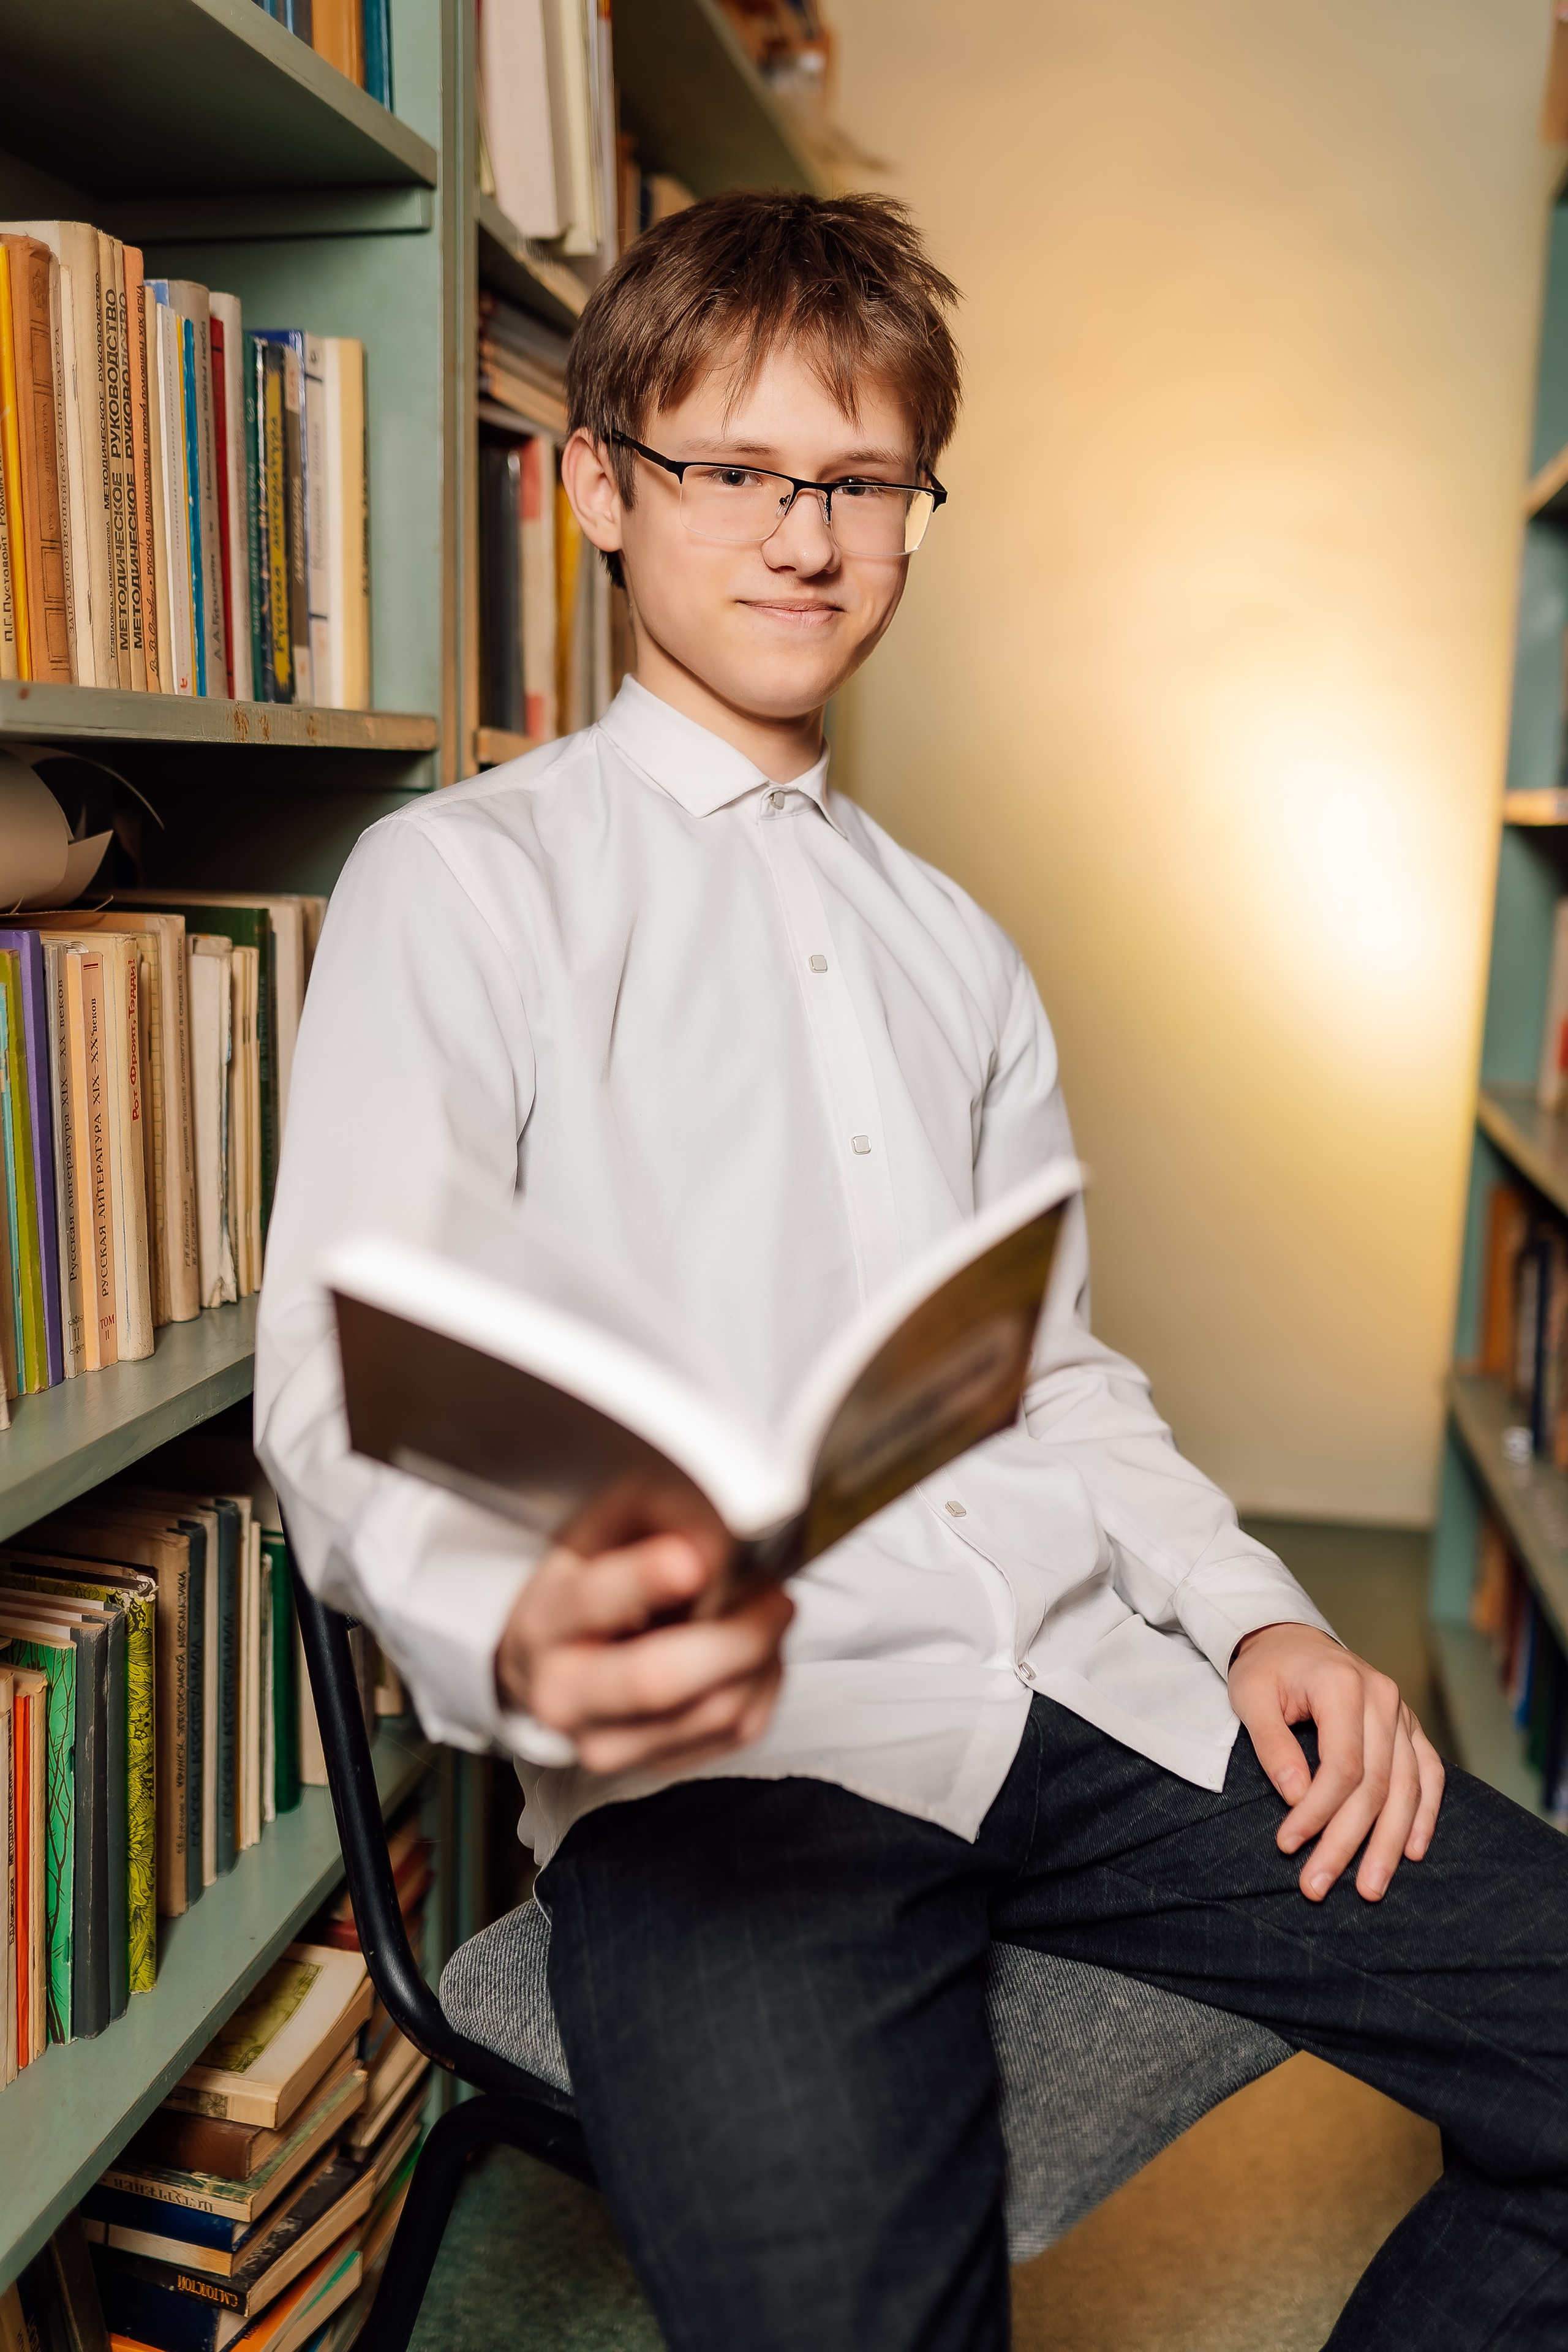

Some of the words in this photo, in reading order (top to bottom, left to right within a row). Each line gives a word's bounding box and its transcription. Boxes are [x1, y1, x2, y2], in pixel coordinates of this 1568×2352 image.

[95, 271, 104, 383] РУКОВОДСТВО
[135, 284, 145, 313] ВЕКА
[55, 326, 64, 435] ЛИТЕРАТУРА
[105, 288, 121, 459] РУКОВОДСТВО
[138, 341, 147, 400] ПОЛОВИНЫ
[42, 403, 52, 474] ЛИТЕРАТУРА
[99, 390, 110, 510] МЕТОДИЧЕСКОЕ
[138, 403, 149, 444] ВТОРОЙ
[143, 448, 153, 522] ДРАМАТУРГИЯ
[59, 440, 75, 635] ЗАПАДНОЕВРОПЕЙСКАЯ
[111, 472, 129, 650] МЕТОДИЧЕСКОЕ
[126, 472, 143, 649] МЕТОДИЧЕСКОЕ
[57, 979, 66, 1028] веков
[89, 998, 98, 1032] веков
[127, 959, 137, 1020] Тэдди!
[59, 1034, 67, 1058] XX
[129, 1019, 138, 1086] Фронт,
[59, 1076, 69, 1106] XIX
[131, 1090, 140, 1121] Рот
[63, 1112, 76, 1210] литература
[93, 1112, 107, 1219] ЛИТЕРАТУРА
[67, 1216, 79, 1282] Русская
[97, 1224, 110, 1297] РУССКАЯ
[99, 1314, 116, 1330] ТОМ
[176, 1570, 187, 1649] АВТОМАТИКИ
[175, 1652, 186, 1737] ЭЛЕКТРОННОЙ
